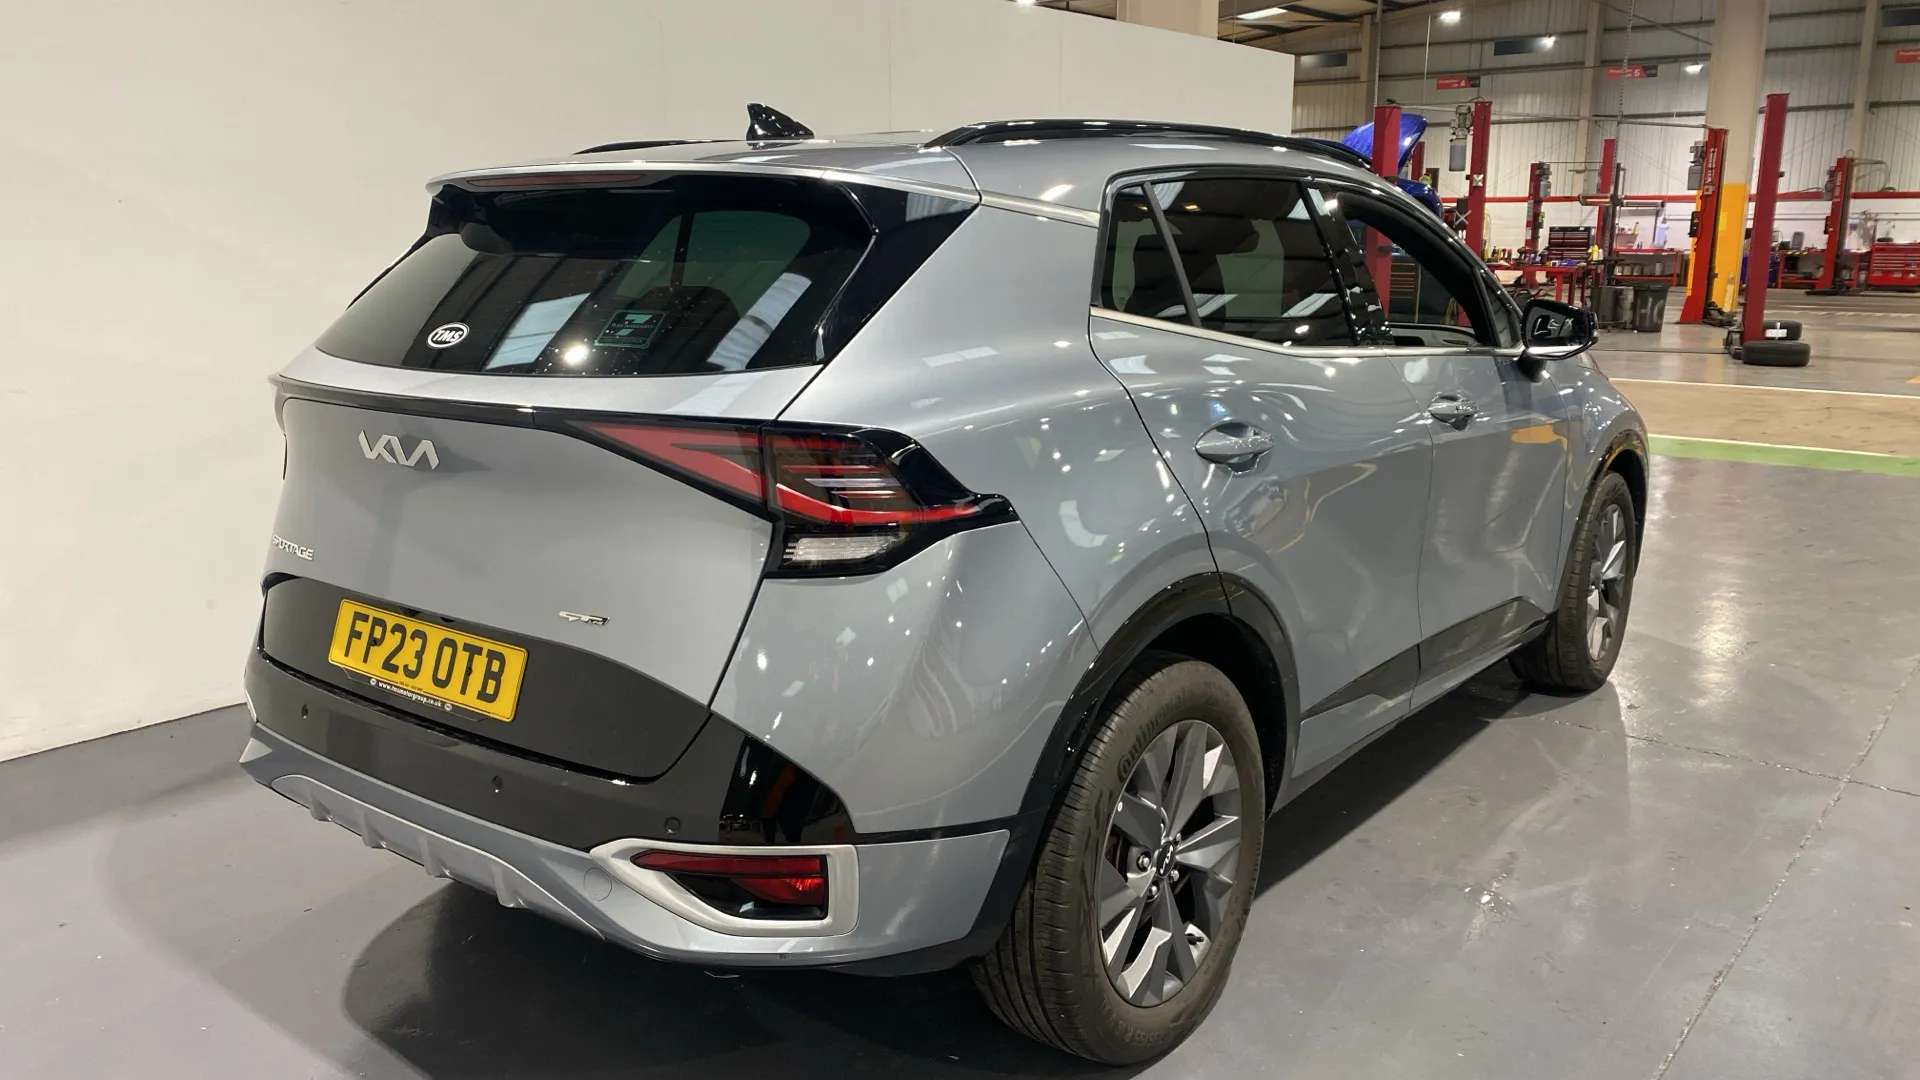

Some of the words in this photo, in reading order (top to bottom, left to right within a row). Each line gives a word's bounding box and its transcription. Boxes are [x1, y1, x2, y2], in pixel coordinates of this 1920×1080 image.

[431, 329, 464, 343] TMS
[358, 429, 440, 470] KIA
[272, 533, 314, 561] SPORTAGE
[343, 610, 428, 680] FP23
[431, 637, 507, 704] OTB
